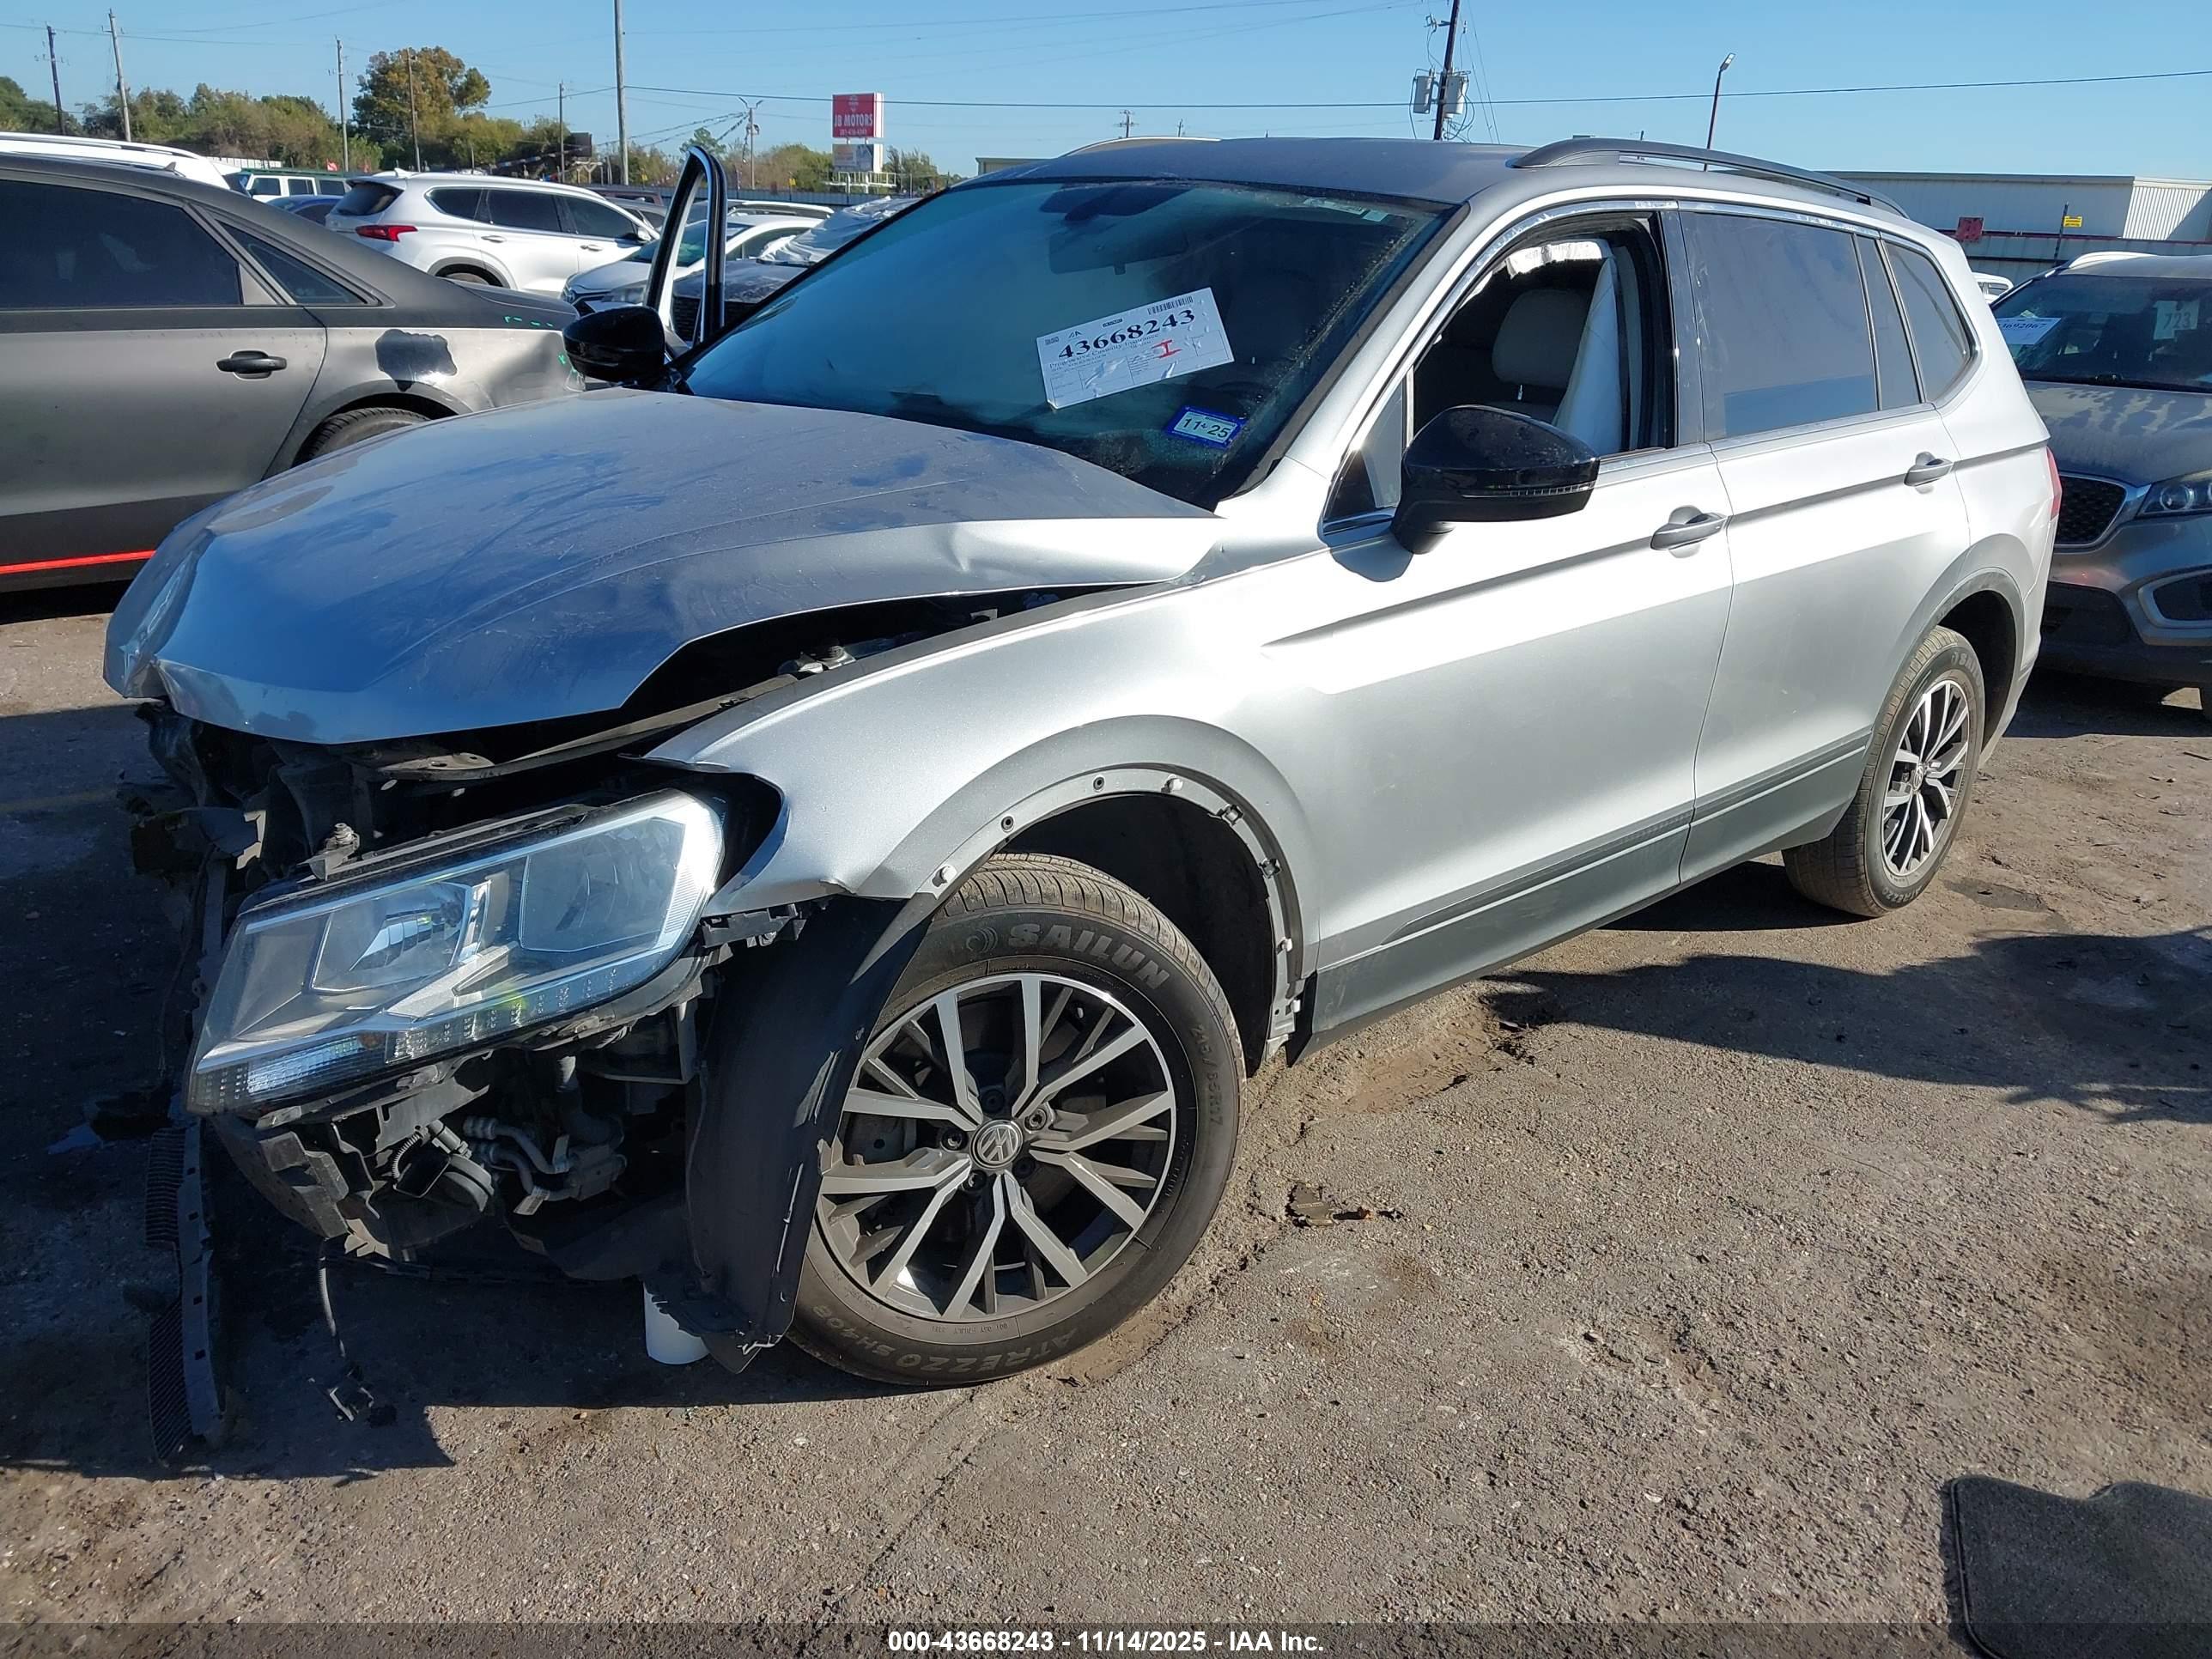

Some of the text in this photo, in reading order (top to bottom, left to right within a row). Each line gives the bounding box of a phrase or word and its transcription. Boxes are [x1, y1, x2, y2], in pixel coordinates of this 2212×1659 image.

[835, 113, 872, 127] JB MOTORS
[1059, 310, 1194, 358] 43668243
[1183, 417, 1202, 430] 11
[1206, 424, 1232, 438] 25
[1008, 922, 1170, 989] SAILUN
[896, 1328, 1077, 1372] ATREZZO
